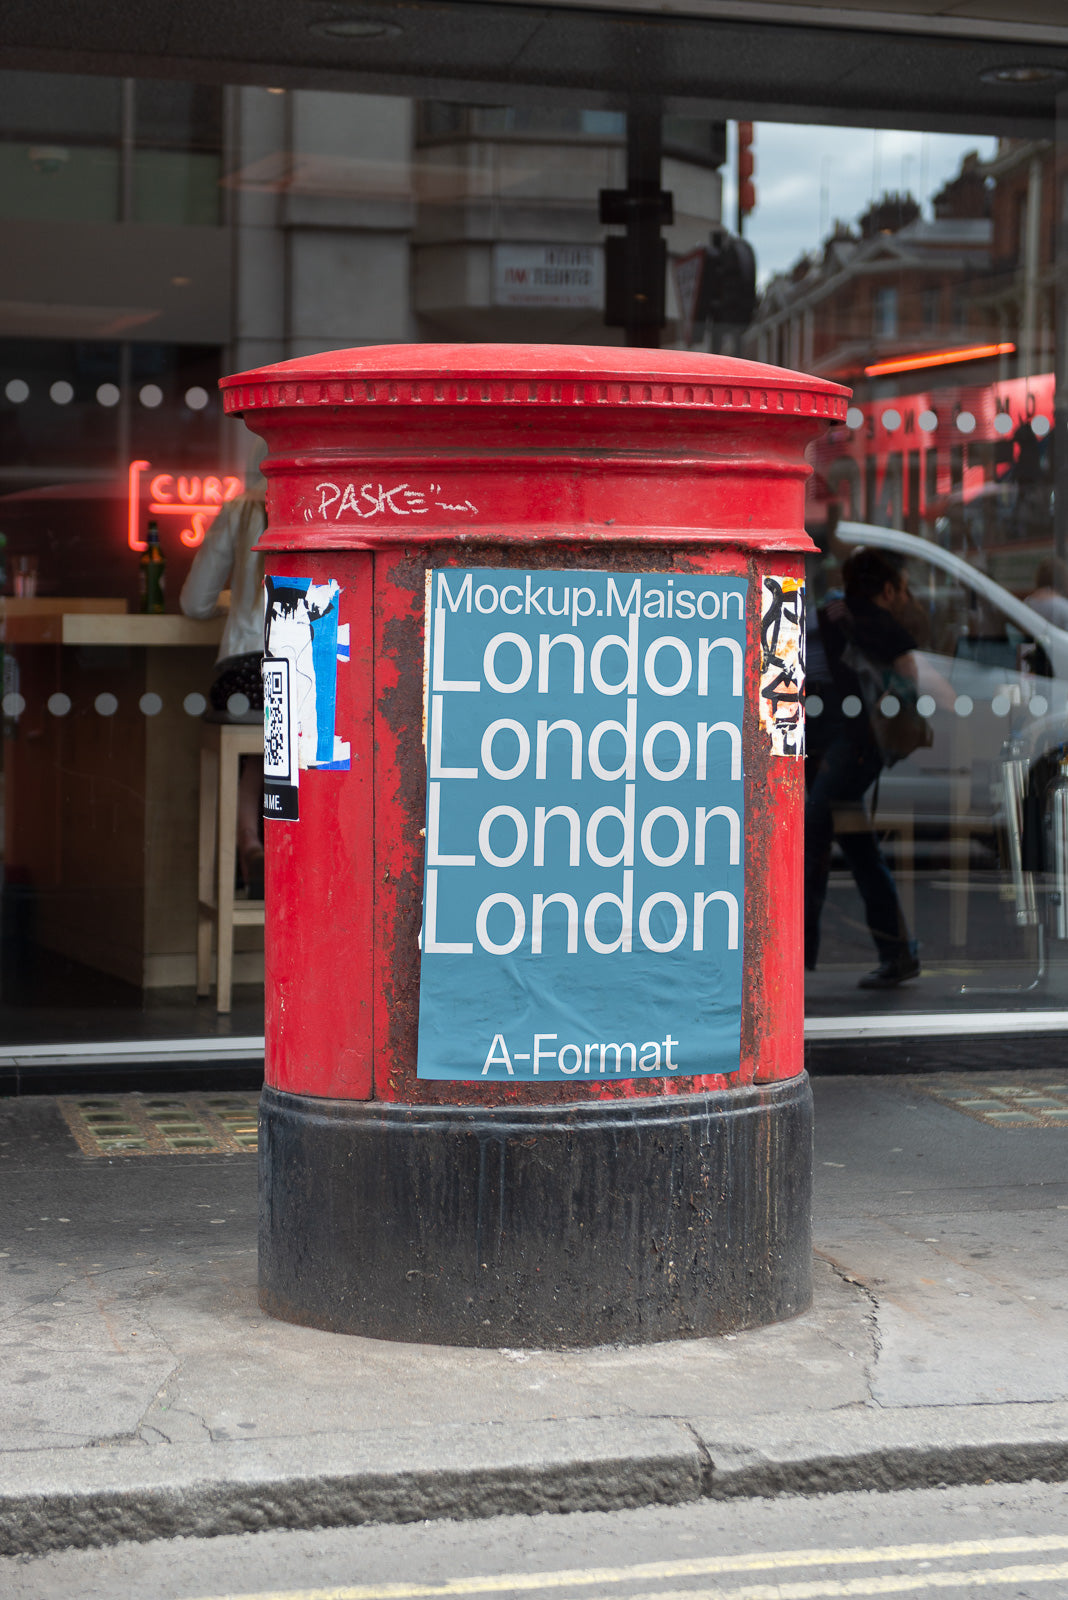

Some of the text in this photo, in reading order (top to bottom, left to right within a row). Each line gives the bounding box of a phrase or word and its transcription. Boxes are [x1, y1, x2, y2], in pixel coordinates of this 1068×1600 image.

[436, 572, 744, 626] Mockup.Maison
[432, 608, 743, 696] London
[429, 695, 742, 781] London
[427, 782, 741, 867] London
[424, 869, 739, 955] London
[481, 1033, 679, 1075] A-Format
